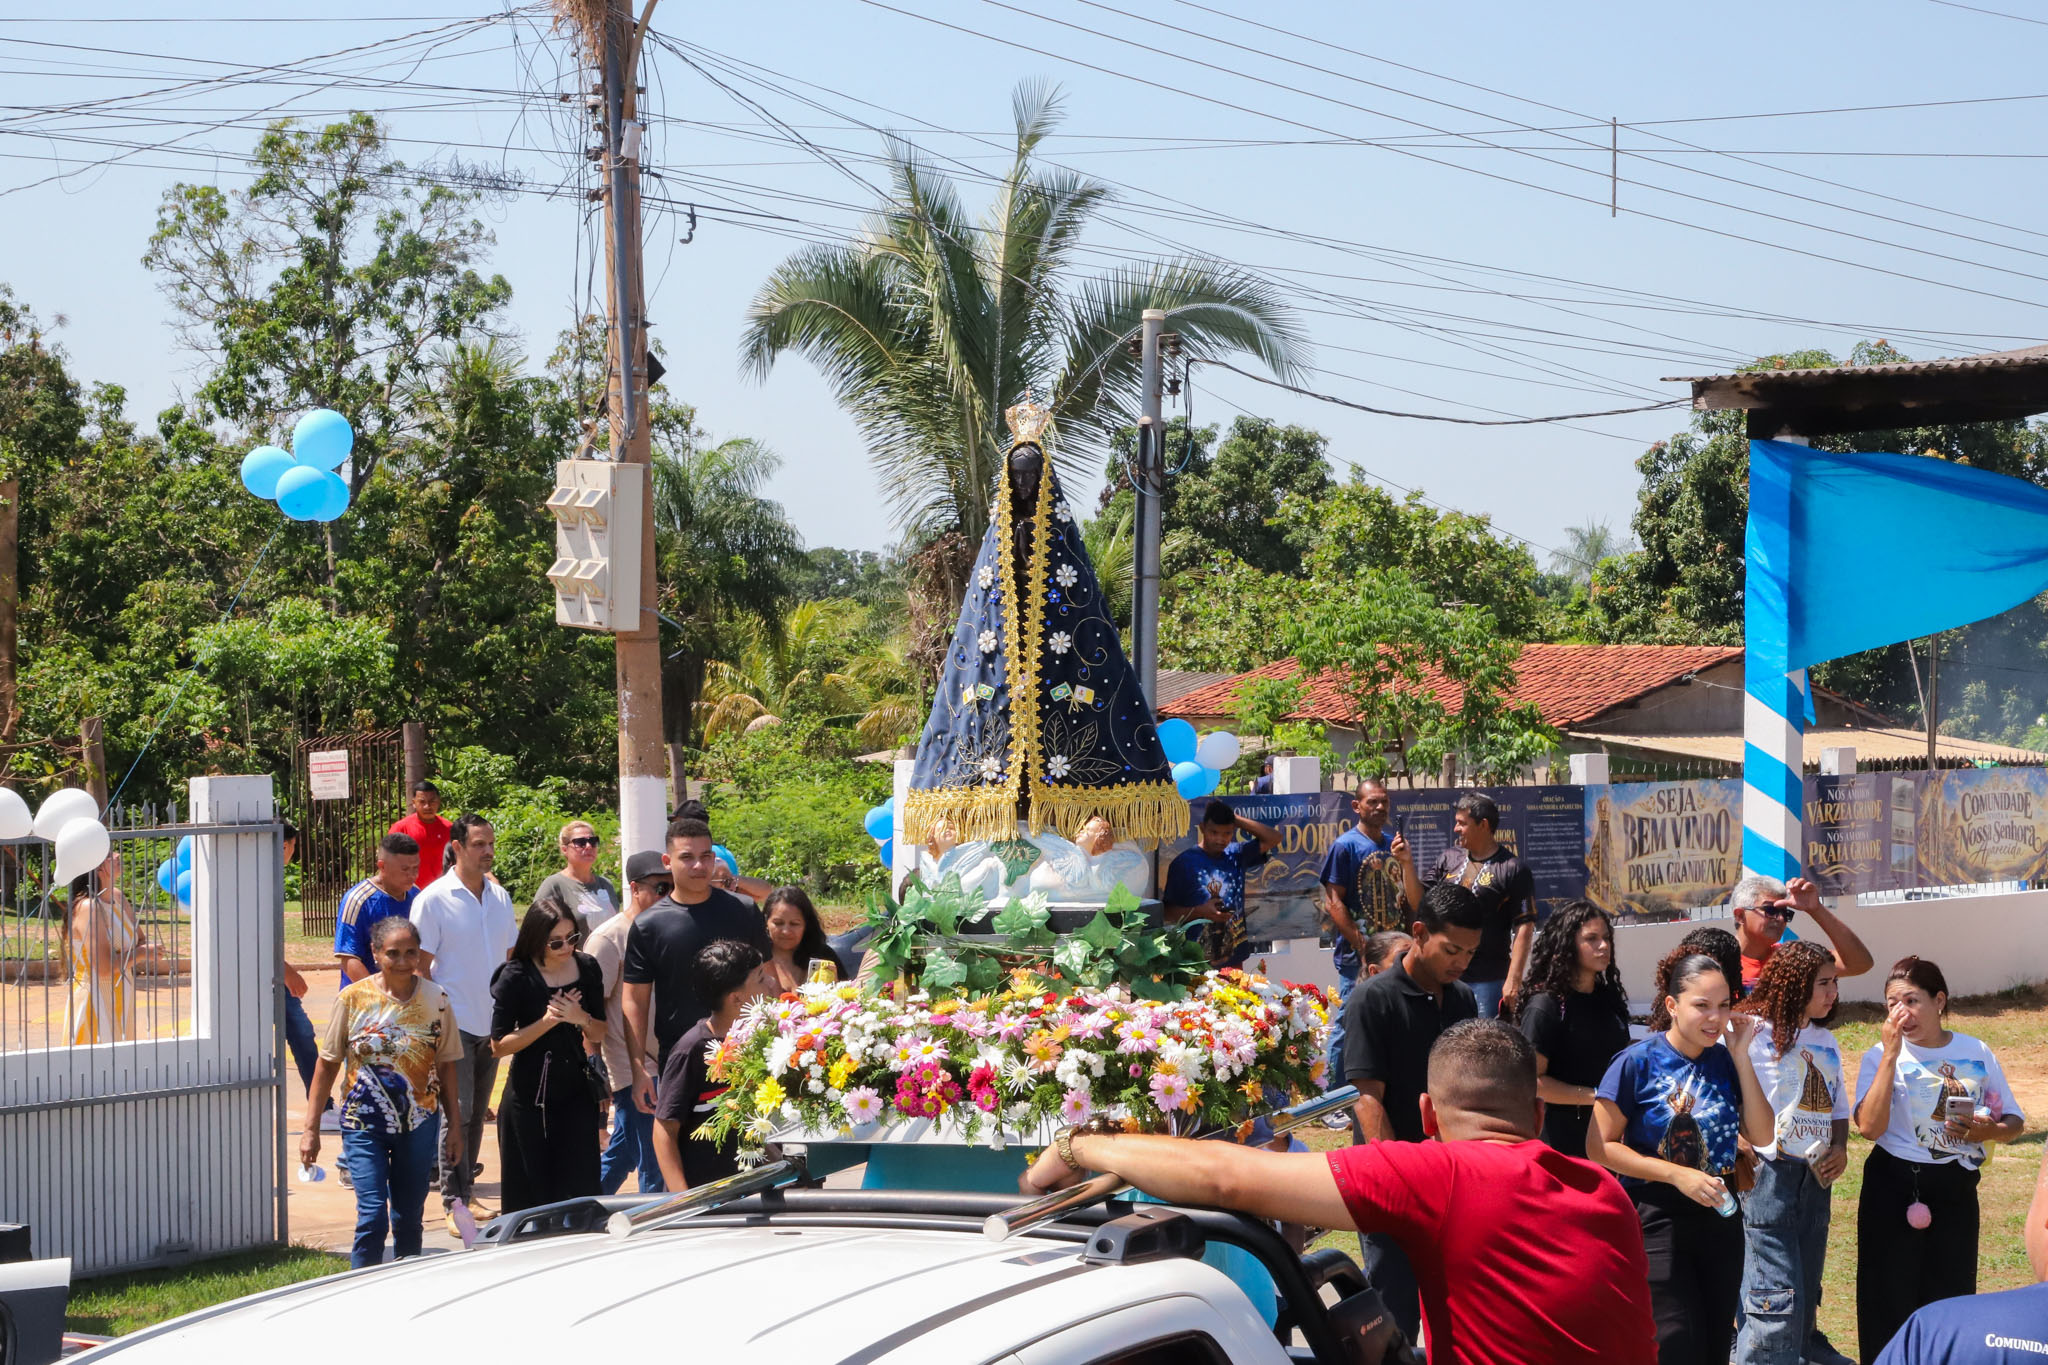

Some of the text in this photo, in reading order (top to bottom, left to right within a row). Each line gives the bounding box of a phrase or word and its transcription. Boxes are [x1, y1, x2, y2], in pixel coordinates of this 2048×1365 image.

[1656, 787, 1697, 816] SEJA
[1827, 788, 1845, 801] NÓS
[1961, 792, 2033, 822] COMUNIDADE
[1233, 804, 1327, 820] OMUNIDADE DOS
[1806, 798, 1883, 827] VÁRZEA GRANDE
[1622, 808, 1731, 862] BEM VINDO
[1826, 830, 1844, 842] NÓS
[1955, 820, 2042, 857] Nossa Senhora
[1808, 839, 1883, 867] PRAIA GRANDE
[1968, 841, 2024, 868] Aparecida
[1628, 858, 1727, 894] PRAIA GRANDE/VG
